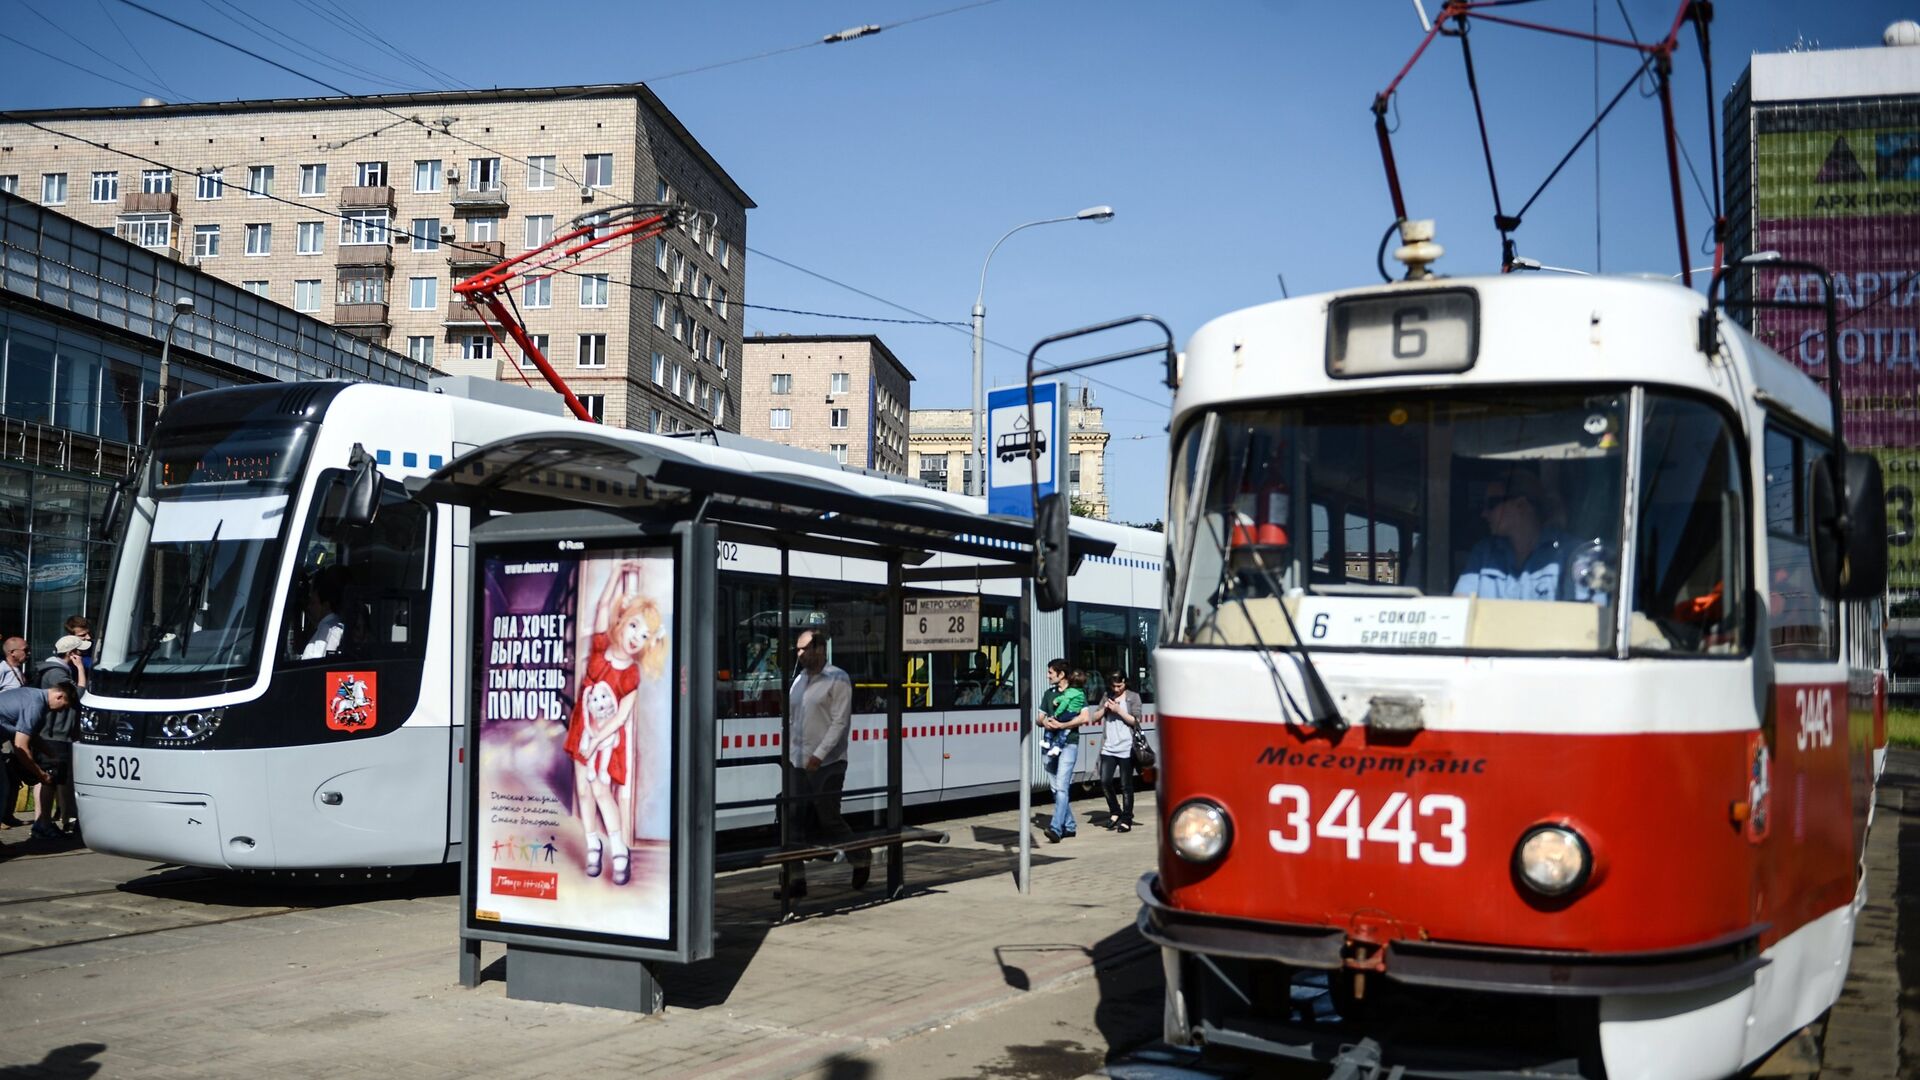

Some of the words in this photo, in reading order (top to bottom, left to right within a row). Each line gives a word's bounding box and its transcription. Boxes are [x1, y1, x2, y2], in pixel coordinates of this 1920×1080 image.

[1393, 306, 1428, 359] 6
[920, 600, 944, 609] МЕТРО
[493, 615, 518, 639] ОНА
[521, 614, 567, 638] ХОЧЕТ
[919, 617, 928, 634] 6
[948, 616, 965, 633] 28
[1312, 613, 1330, 639] 6
[1378, 611, 1426, 624] СОКОЛ
[1361, 631, 1438, 645] БРАТЦЕВО
[490, 639, 569, 664] ВЫРАСТИ.
[487, 690, 567, 720] ПОМОЧЬ.
[1796, 688, 1833, 751] 3443
[95, 754, 141, 781] 3502
[1257, 747, 1488, 778] Мосгортранс
[1268, 783, 1467, 867] 3443
